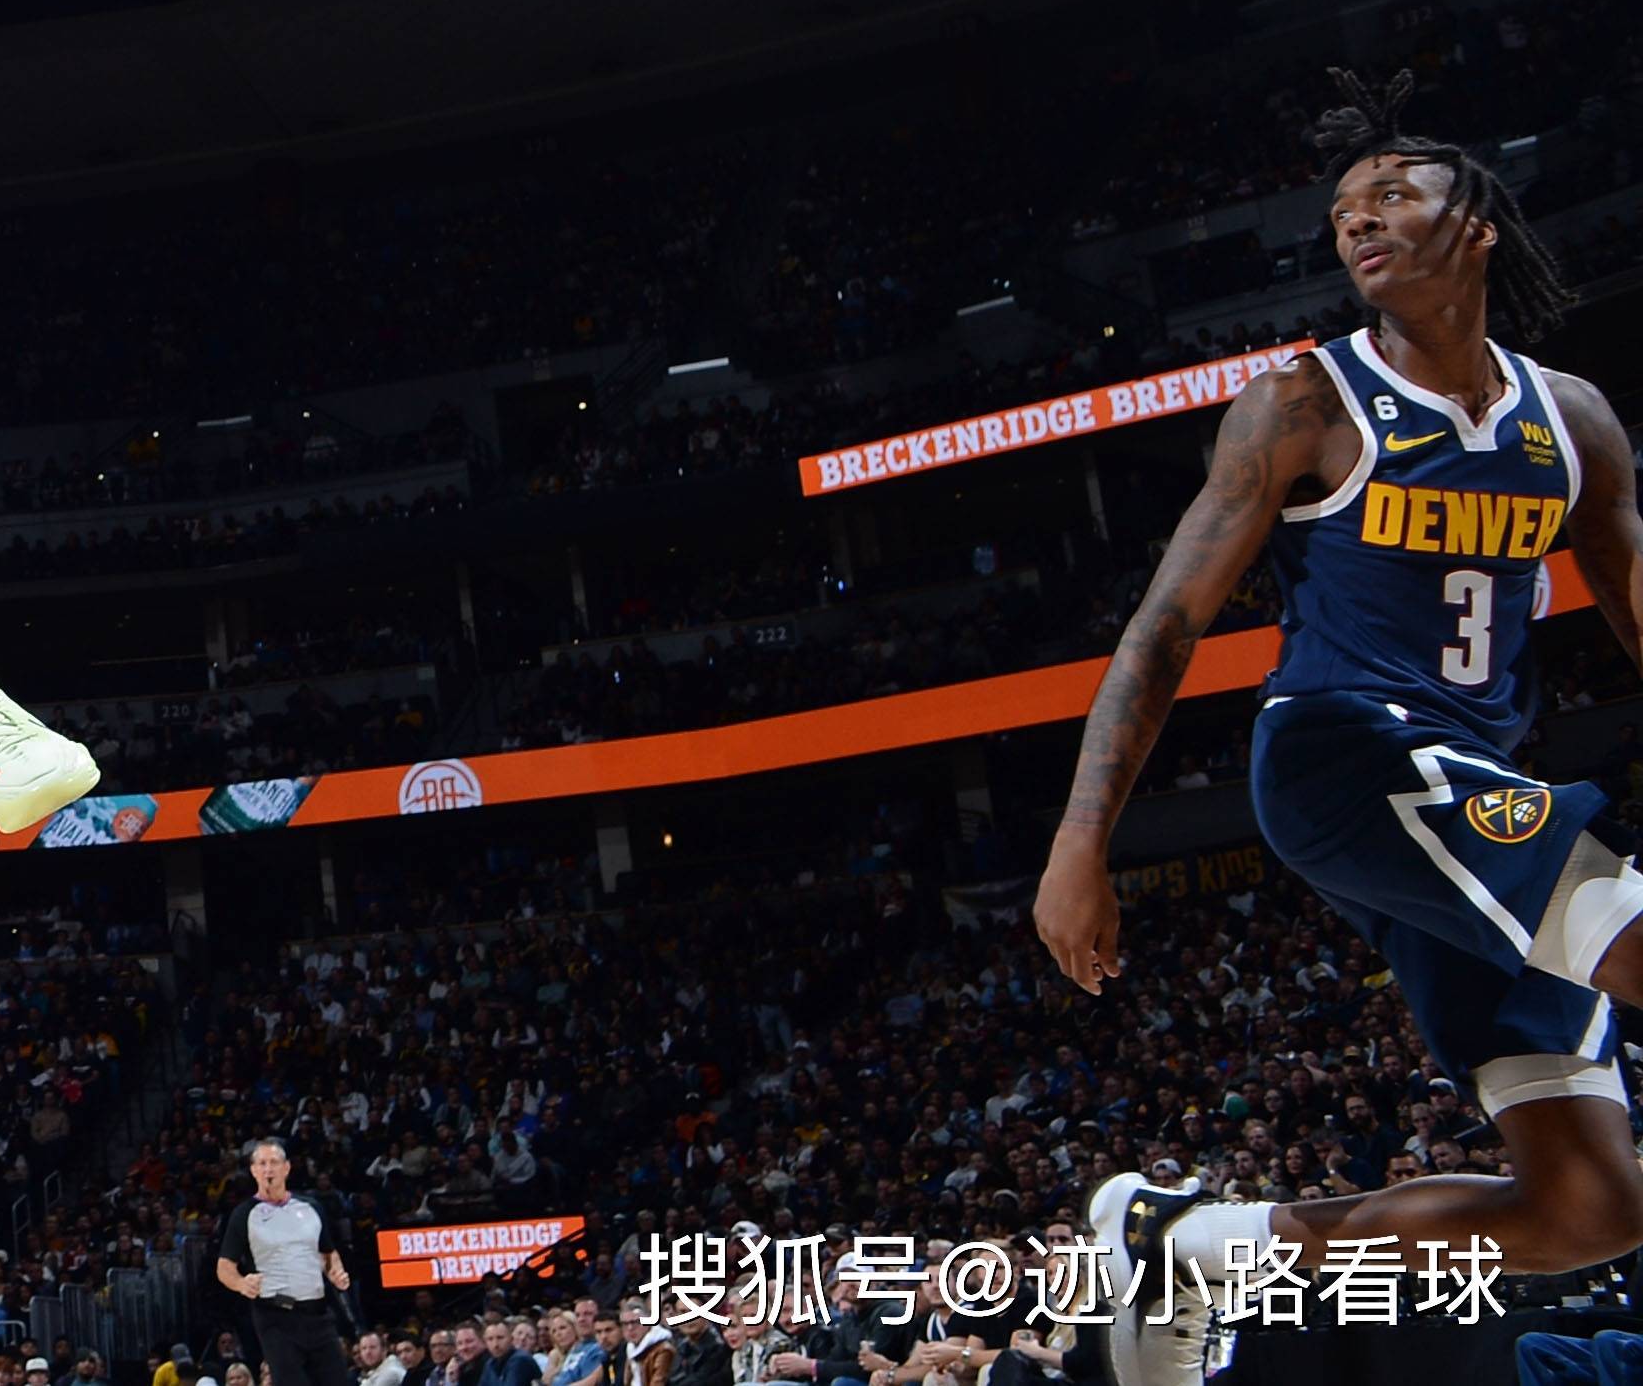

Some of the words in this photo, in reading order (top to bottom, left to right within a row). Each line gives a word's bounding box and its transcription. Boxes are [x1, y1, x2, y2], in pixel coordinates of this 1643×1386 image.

[1373, 395, 1399, 420] 6
[1517, 420, 1554, 447] WU
[817, 397, 1097, 488] BRECKENRIDGE
[1361, 481, 1566, 559] DENVER
[1440, 569, 1494, 686] 3
[398, 1222, 562, 1255] BRECKENRIDGE
